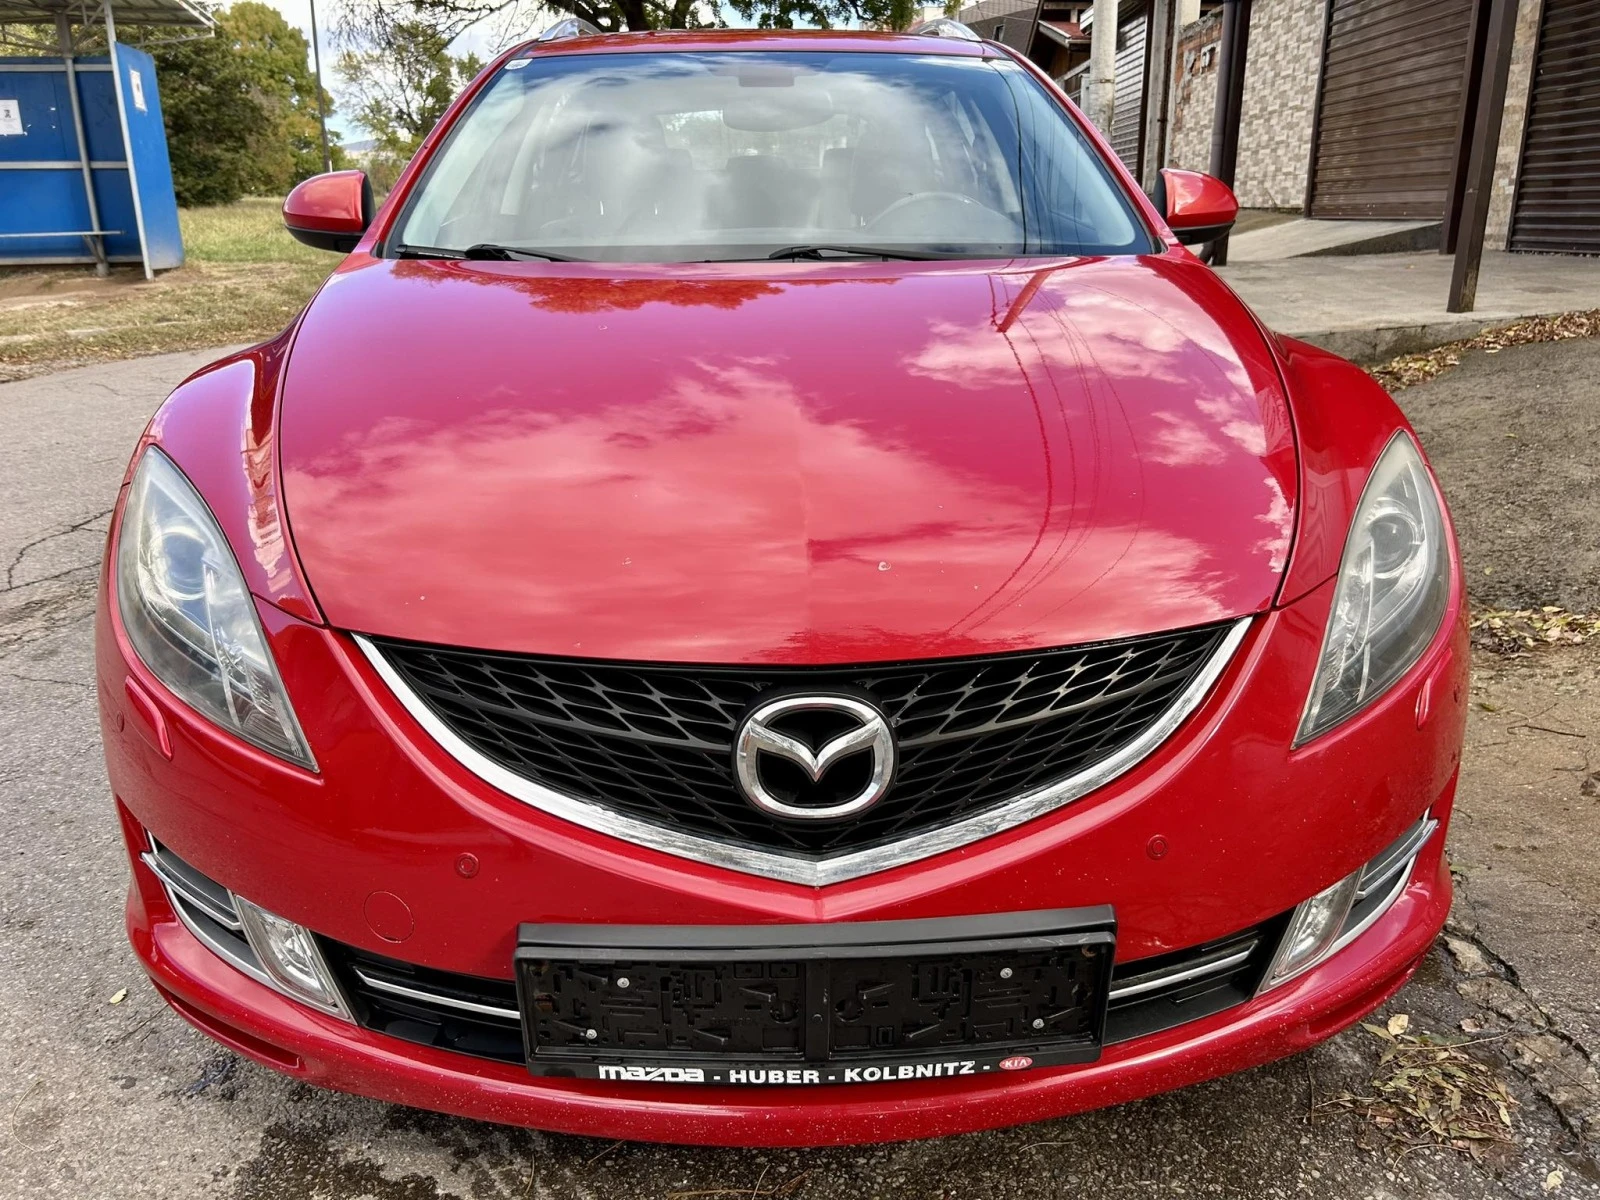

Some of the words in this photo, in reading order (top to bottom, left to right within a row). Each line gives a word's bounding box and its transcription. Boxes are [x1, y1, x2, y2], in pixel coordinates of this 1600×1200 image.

[729, 1069, 820, 1084] HUBER
[844, 1060, 976, 1082] KOLBNITZ
[1004, 1057, 1028, 1068] KIA
